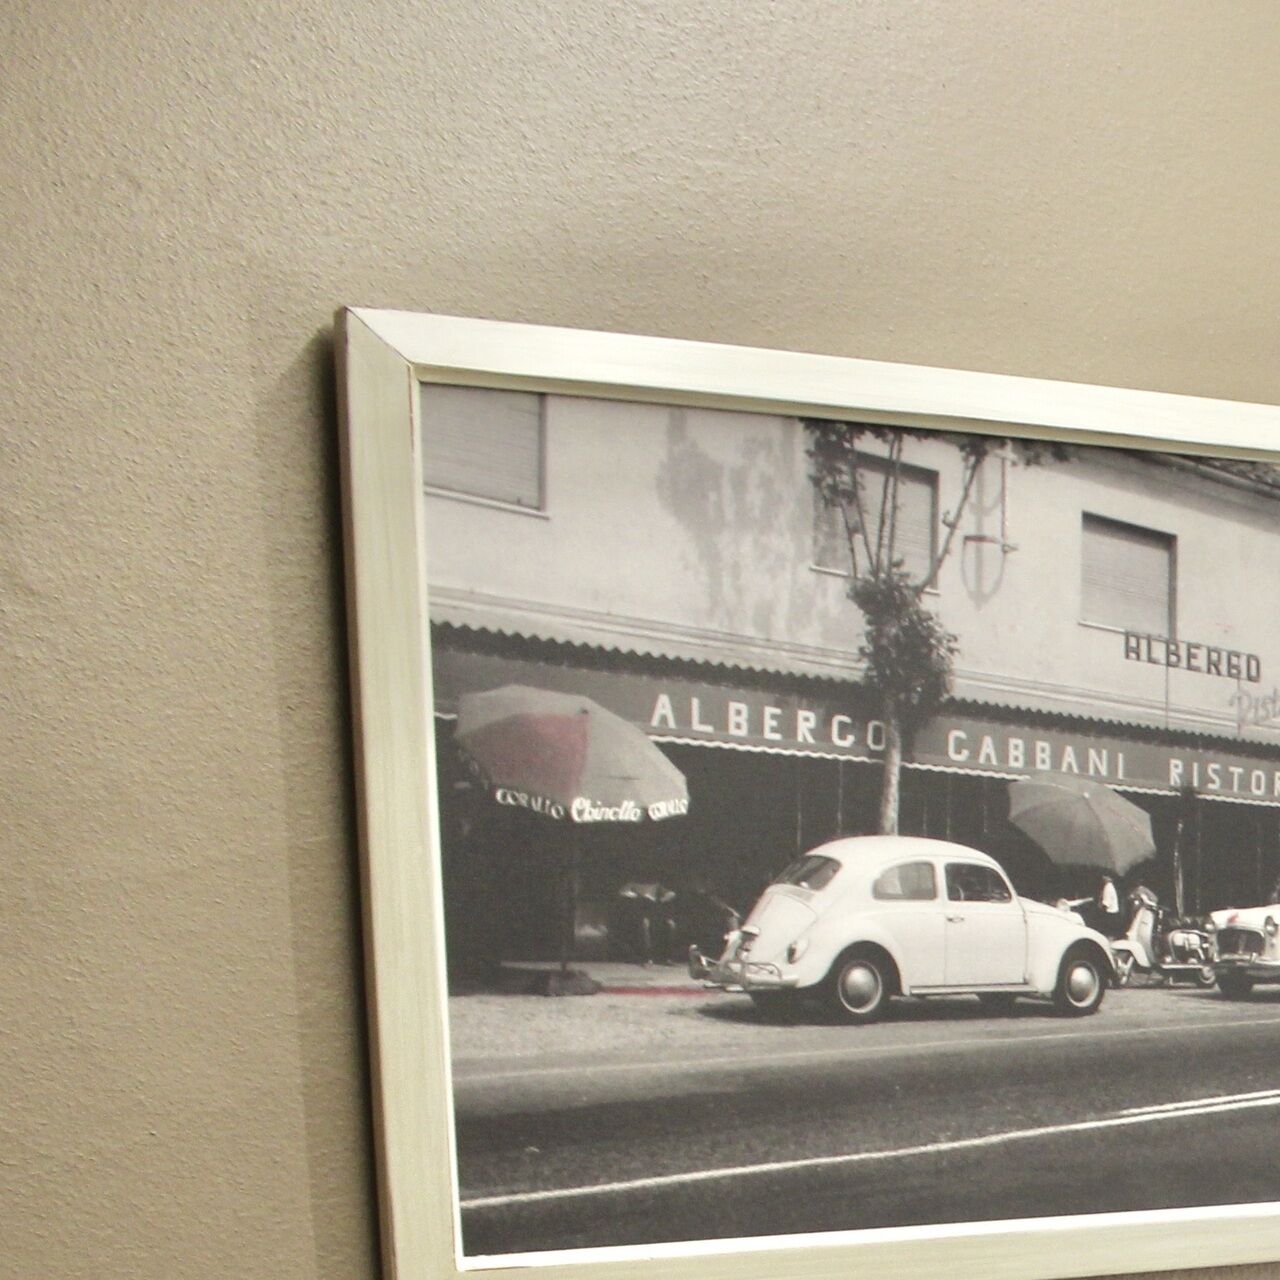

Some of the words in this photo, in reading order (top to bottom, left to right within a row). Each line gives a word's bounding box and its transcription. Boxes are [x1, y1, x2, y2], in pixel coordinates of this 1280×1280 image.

[1124, 631, 1262, 684] ALBERGO
[650, 693, 887, 751] ALBERGO
[948, 729, 1126, 780] GABBANI
